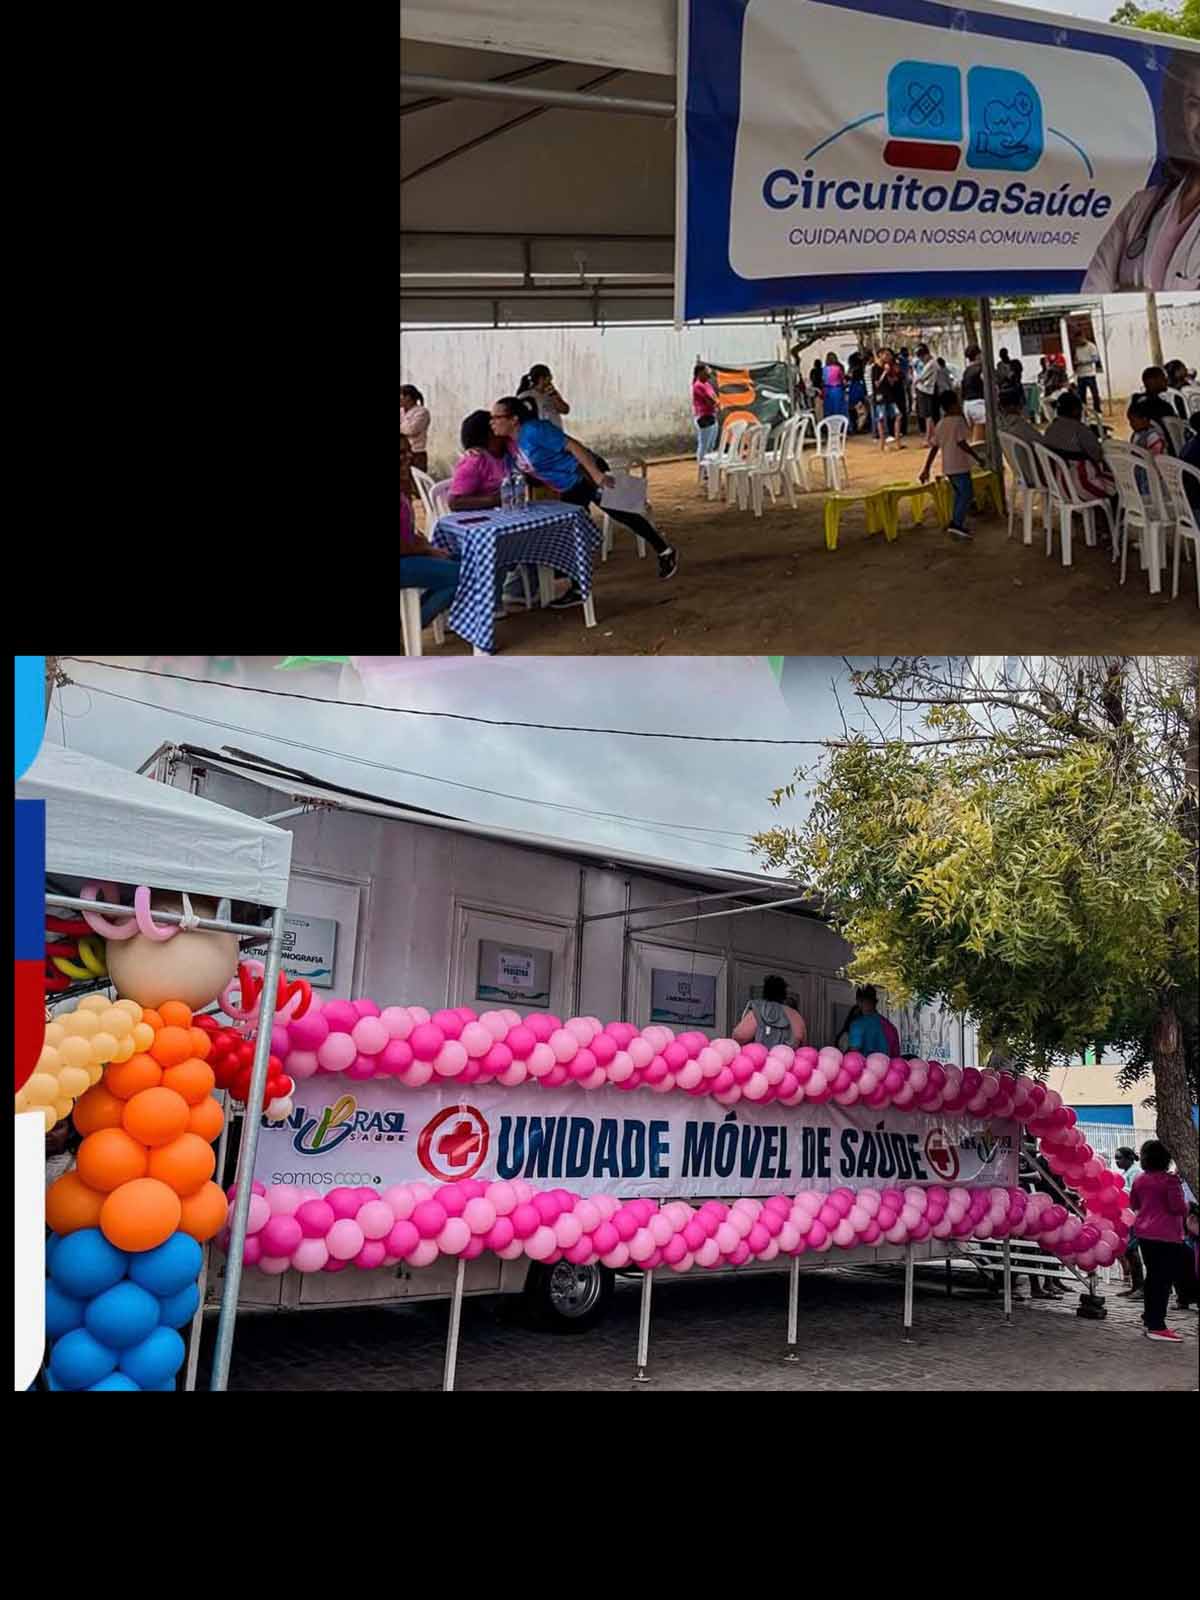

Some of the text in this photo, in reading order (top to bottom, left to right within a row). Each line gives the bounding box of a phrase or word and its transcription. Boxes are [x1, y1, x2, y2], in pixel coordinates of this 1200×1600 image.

[762, 168, 1112, 219] CircuitoDaSaúde
[789, 228, 1080, 246] CUIDANDO DA NOSSA COMUNIDADE
[496, 1110, 928, 1180] UNIDADE MÓVEL DE SAÚDE
